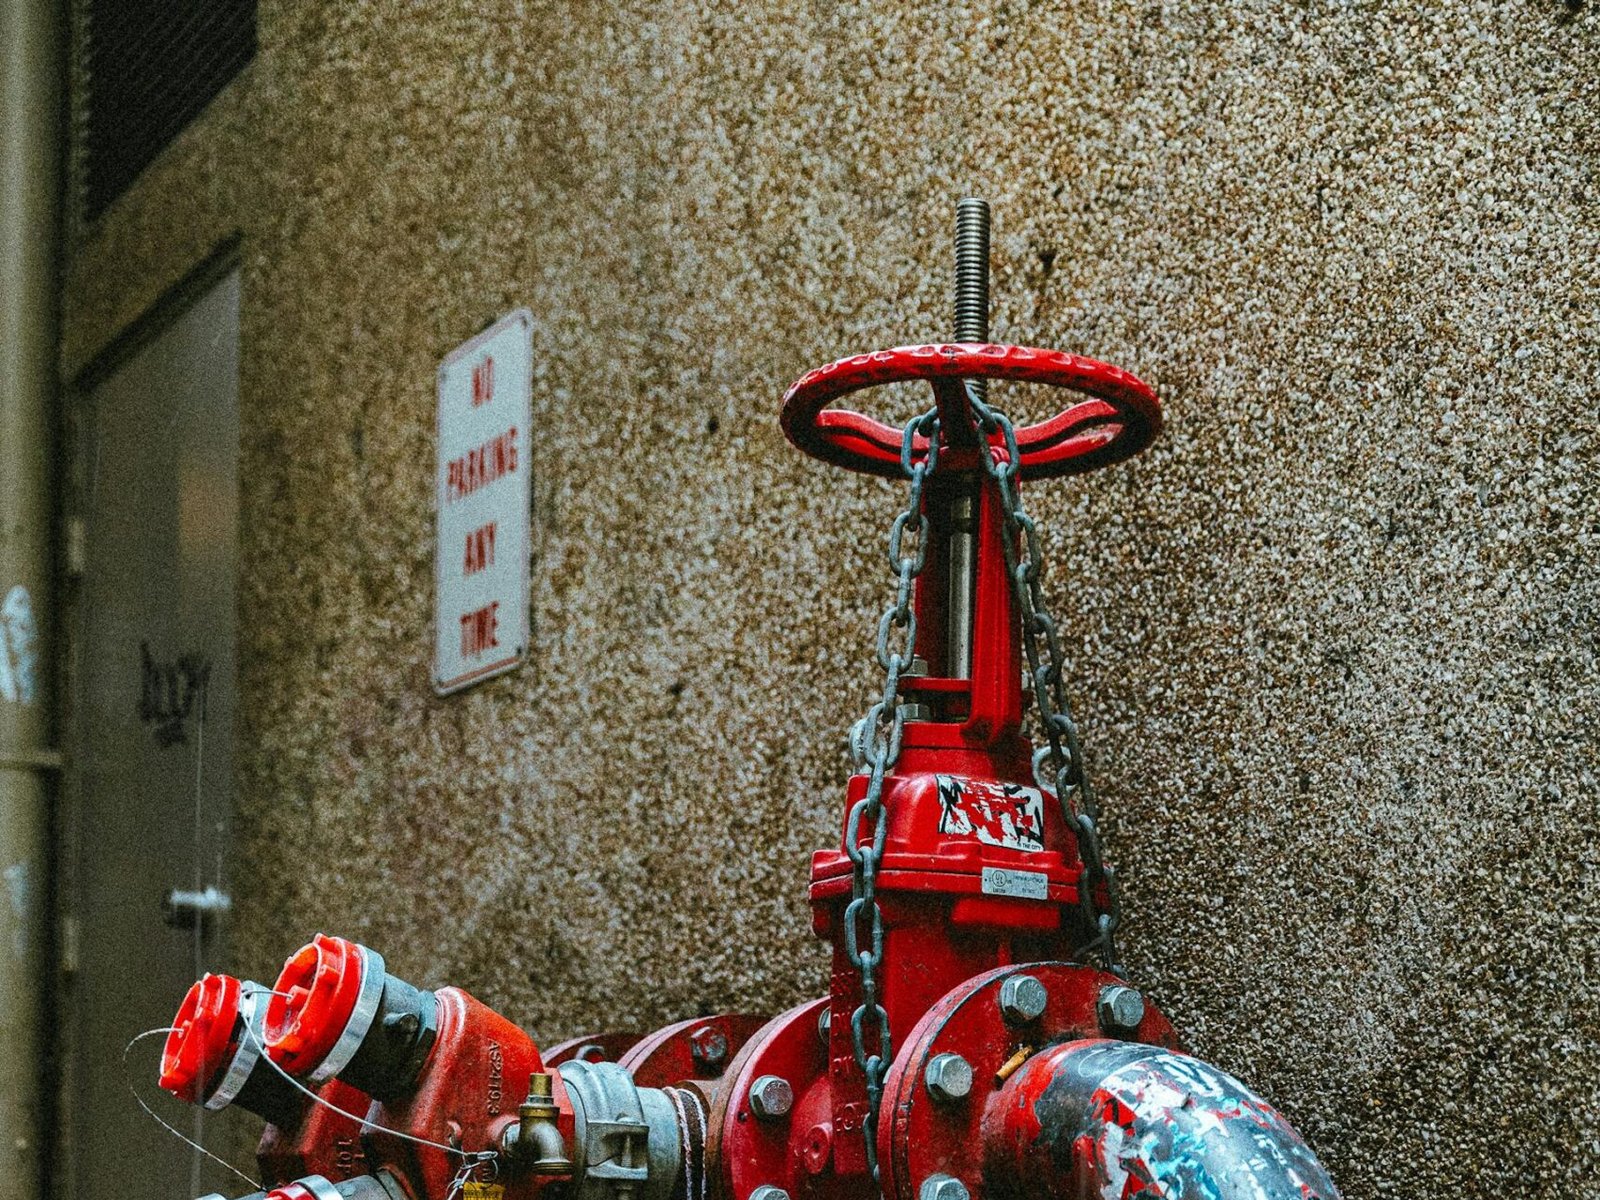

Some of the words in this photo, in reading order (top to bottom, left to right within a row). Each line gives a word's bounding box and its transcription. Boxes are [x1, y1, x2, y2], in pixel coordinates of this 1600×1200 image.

[472, 356, 494, 407] NO
[446, 425, 519, 504] PARKING
[464, 521, 498, 580] ANY
[460, 601, 500, 660] TIME
